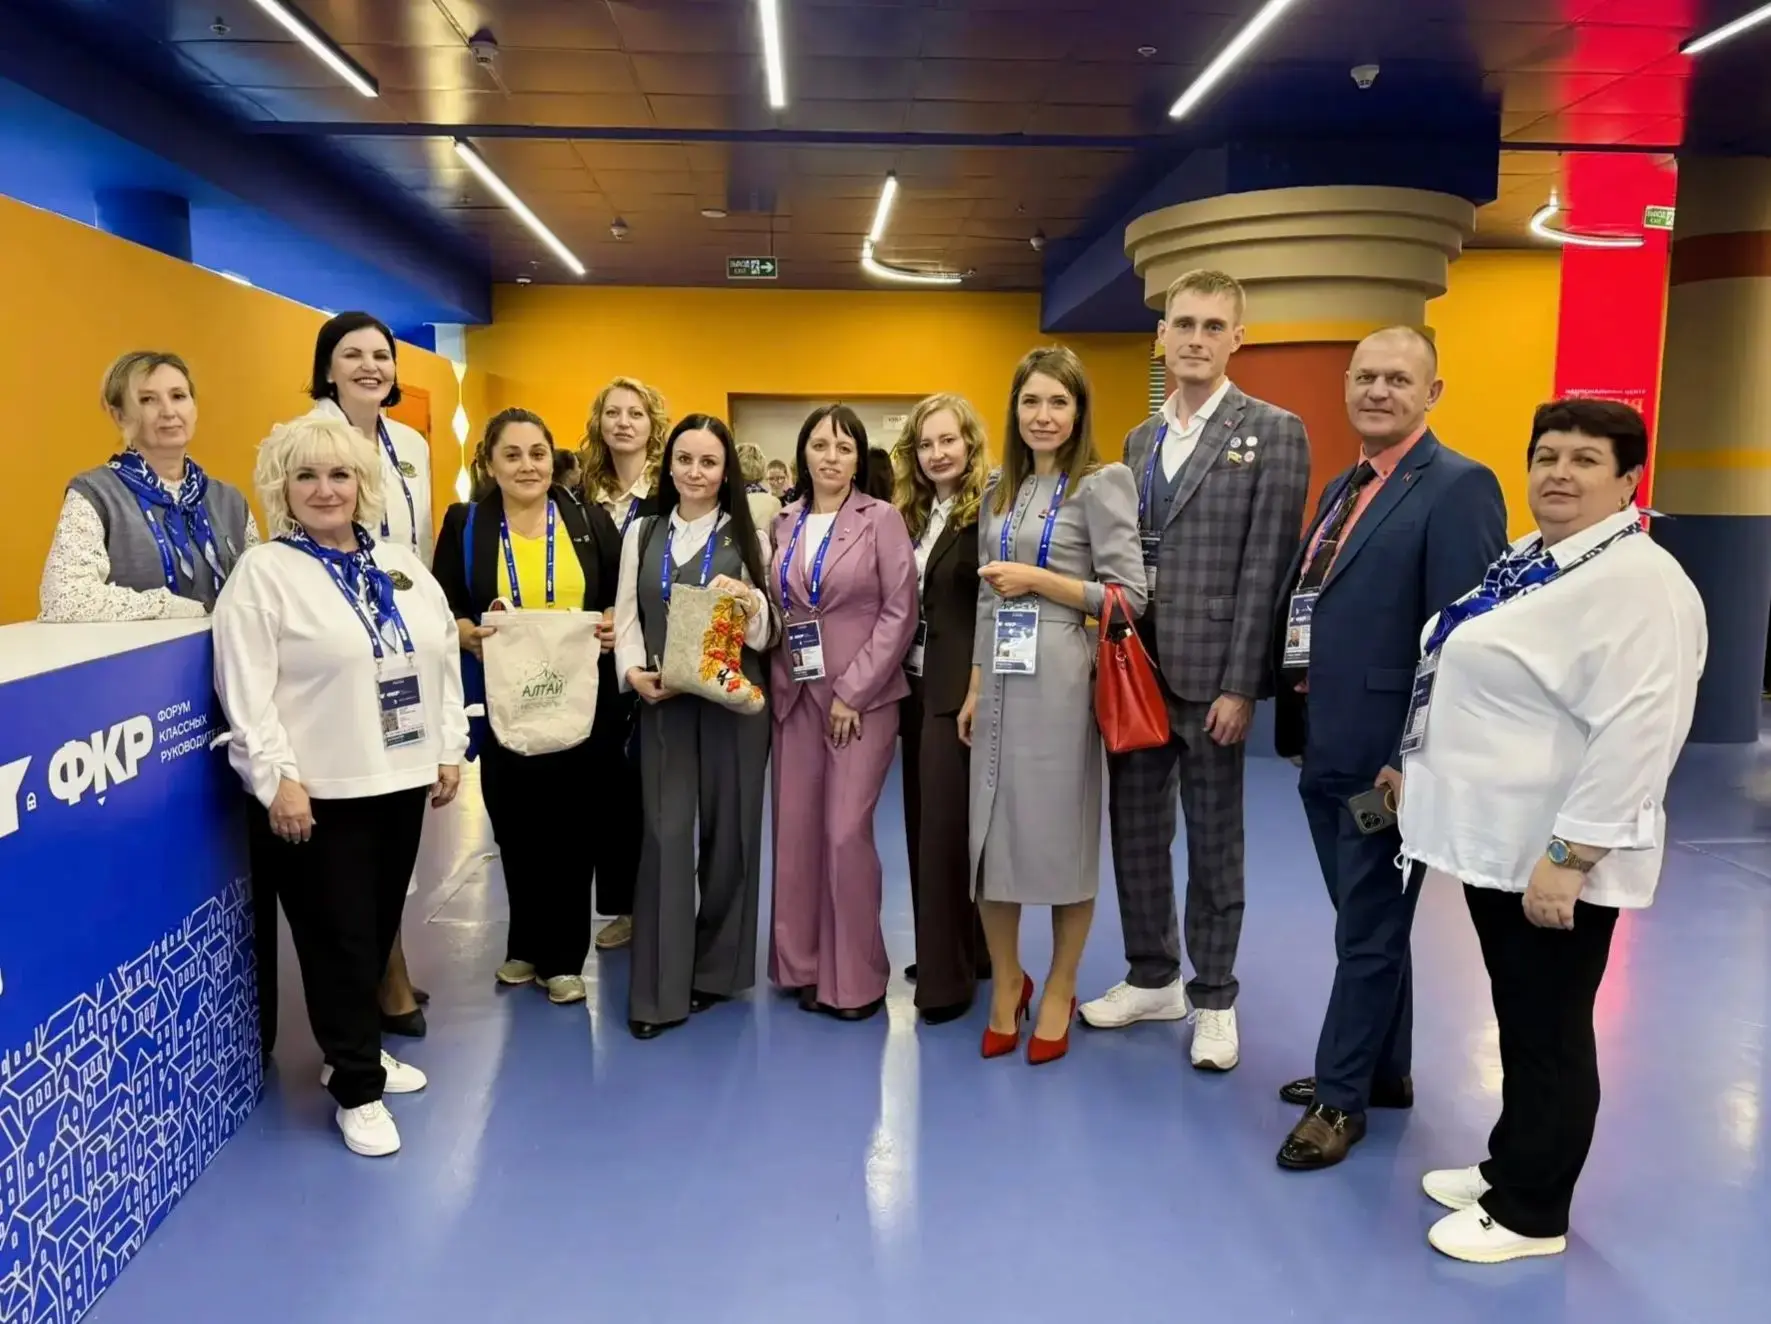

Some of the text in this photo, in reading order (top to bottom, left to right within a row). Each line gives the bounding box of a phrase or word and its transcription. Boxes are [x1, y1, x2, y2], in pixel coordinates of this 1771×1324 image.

[521, 679, 564, 698] АЛТАЙ
[157, 700, 191, 722] ФОРУМ
[159, 714, 208, 743] КЛАССНЫХ
[48, 715, 154, 806] ФКР
